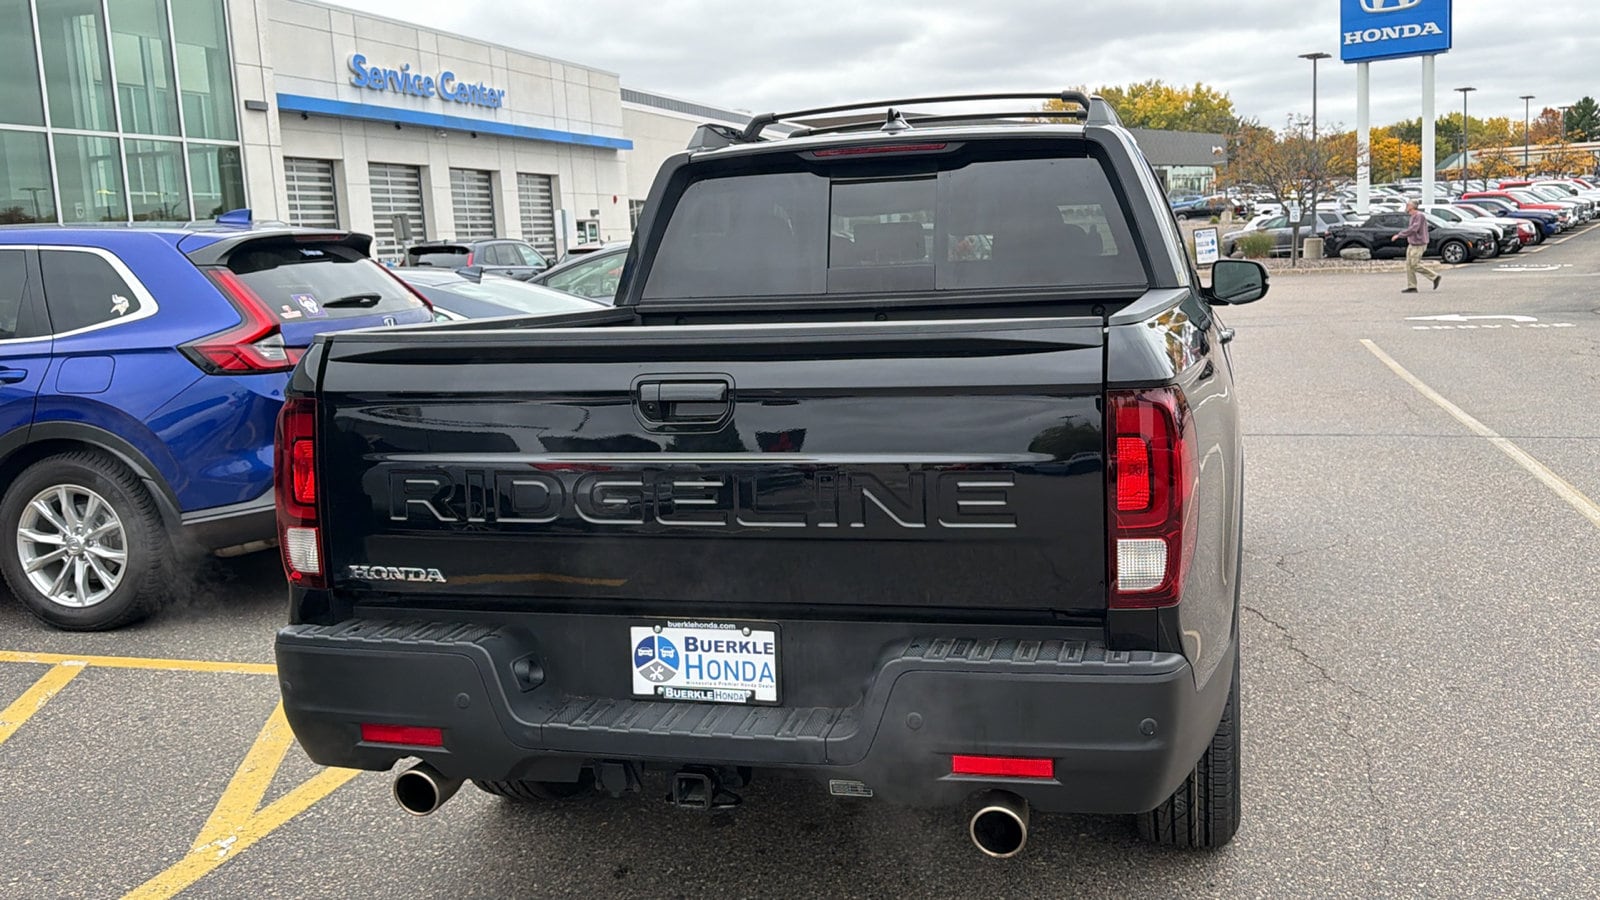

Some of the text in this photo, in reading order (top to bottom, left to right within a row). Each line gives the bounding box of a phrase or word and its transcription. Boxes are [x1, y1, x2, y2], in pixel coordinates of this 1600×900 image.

[1343, 22, 1443, 45] HONDA
[348, 53, 505, 109] Service Center
[388, 469, 1018, 530] RIDGELINE
[348, 565, 447, 583] HONDA
[667, 620, 736, 630] buerklehonda.com
[684, 636, 774, 655] BUERKLE
[684, 654, 775, 683] HONDA
[665, 688, 745, 701] BUERKLE HONDA
